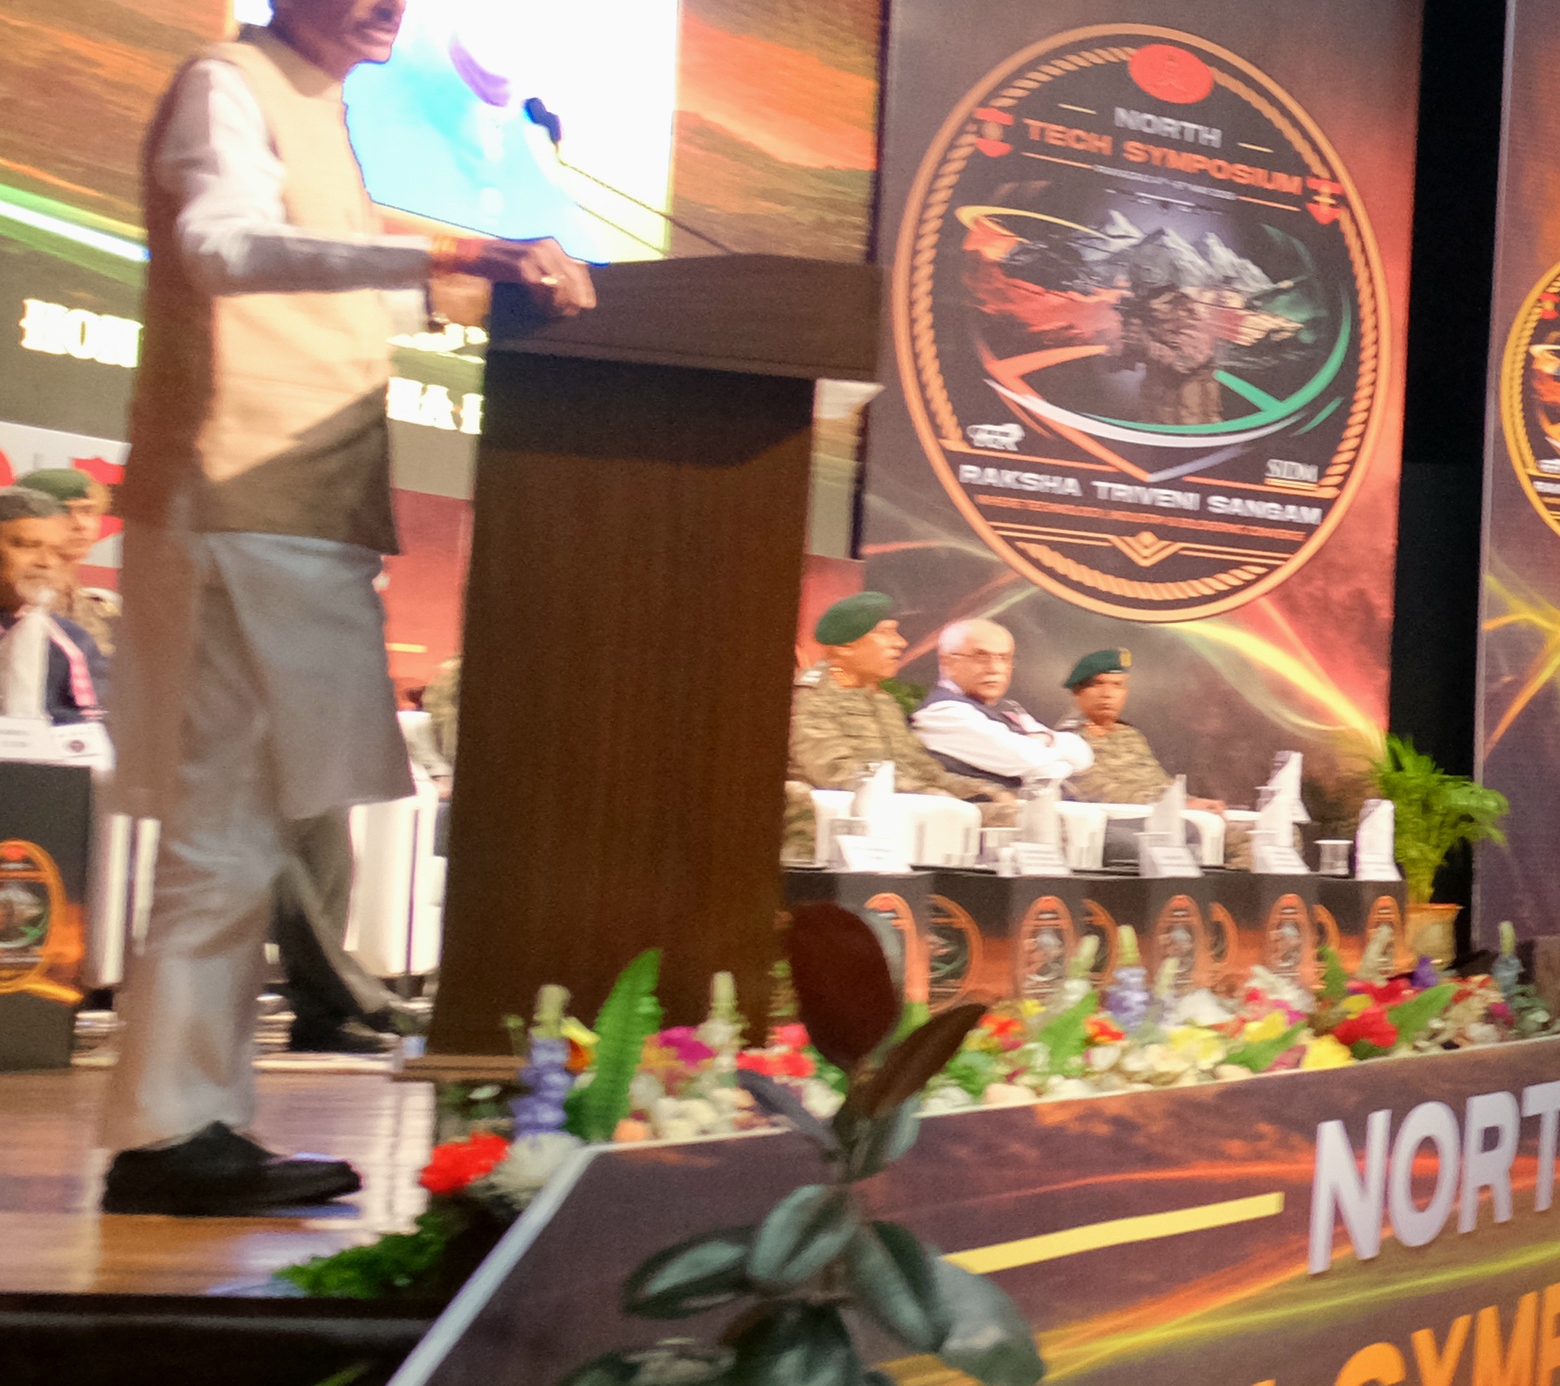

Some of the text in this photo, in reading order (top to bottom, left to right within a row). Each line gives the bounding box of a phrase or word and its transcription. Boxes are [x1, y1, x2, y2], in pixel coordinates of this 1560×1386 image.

[1023, 118, 1113, 156] TECH
[1123, 140, 1304, 195] SYMPOSIUM
[1114, 107, 1222, 148] NORTH
[958, 463, 1082, 498] RAKSHA
[1091, 480, 1201, 511] TRIVENI
[1206, 495, 1322, 525] SANGAM
